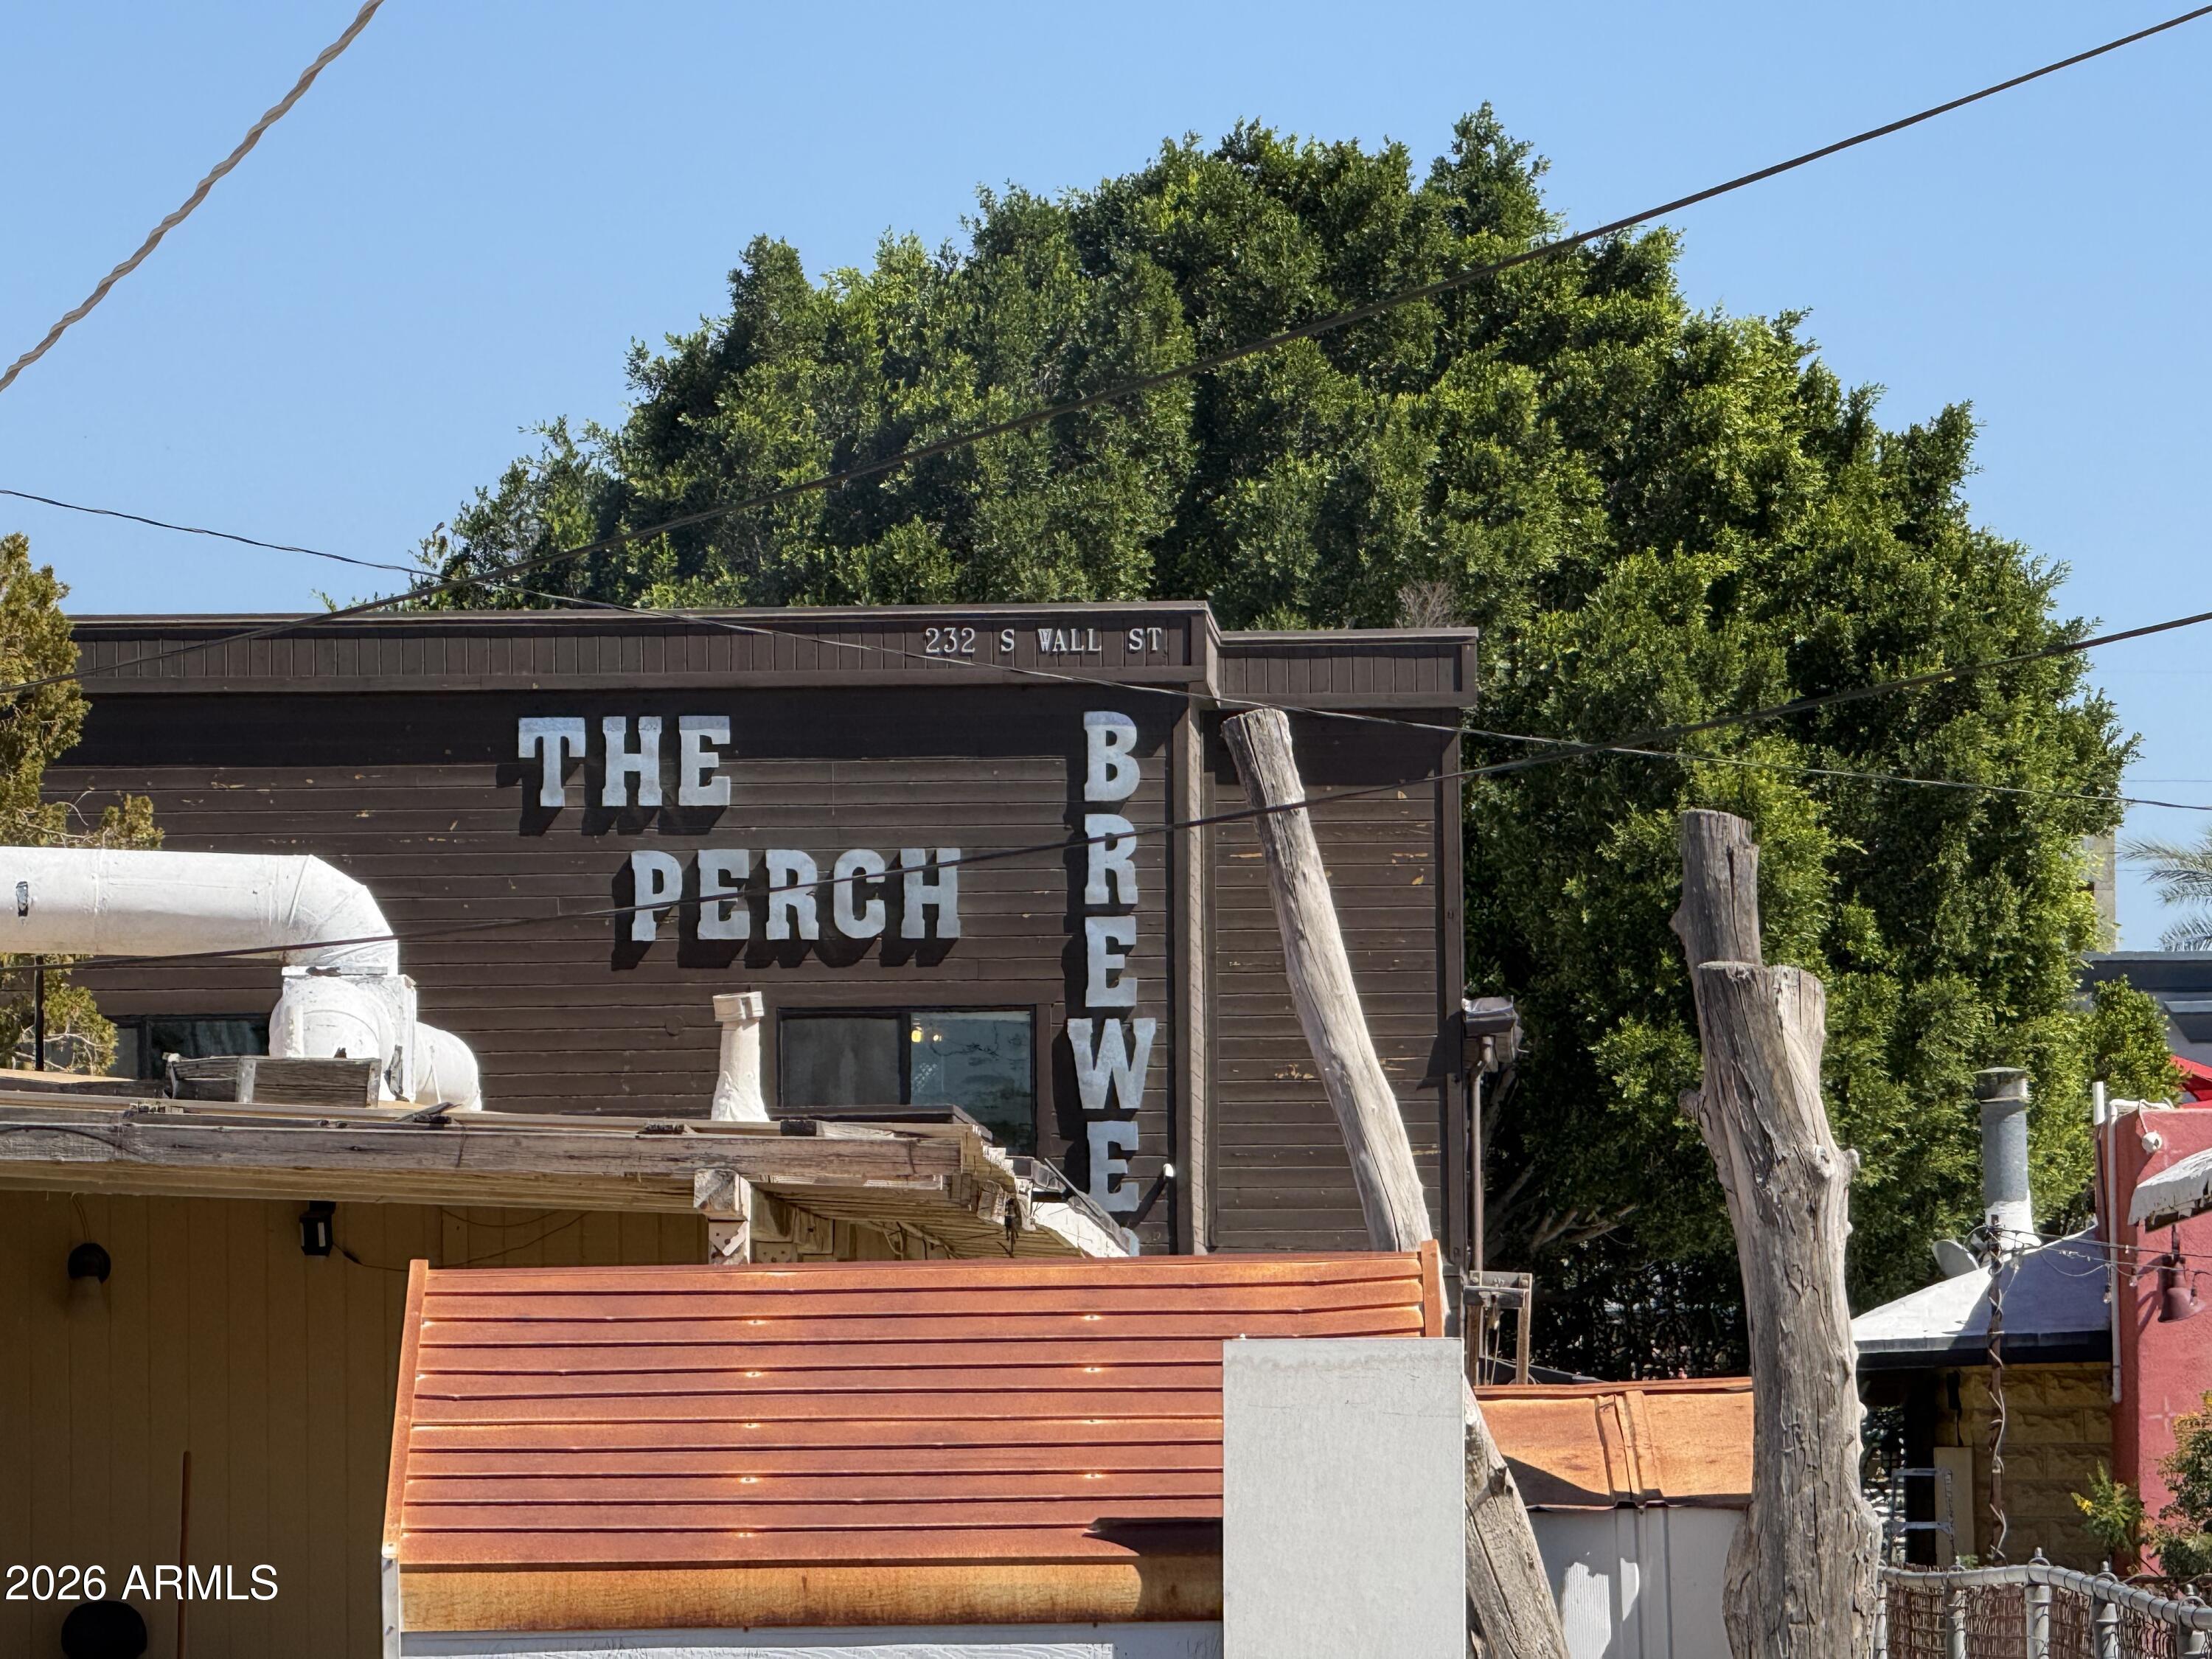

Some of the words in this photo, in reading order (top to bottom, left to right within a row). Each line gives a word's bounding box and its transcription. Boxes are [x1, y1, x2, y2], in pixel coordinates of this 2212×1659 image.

[925, 627, 975, 653] 232
[1001, 629, 1015, 652] S
[1037, 628, 1102, 652] WALL
[1129, 627, 1161, 651] ST
[518, 716, 731, 807] THE
[631, 848, 961, 942] PERCH
[1067, 711, 1156, 1256] BREWE
